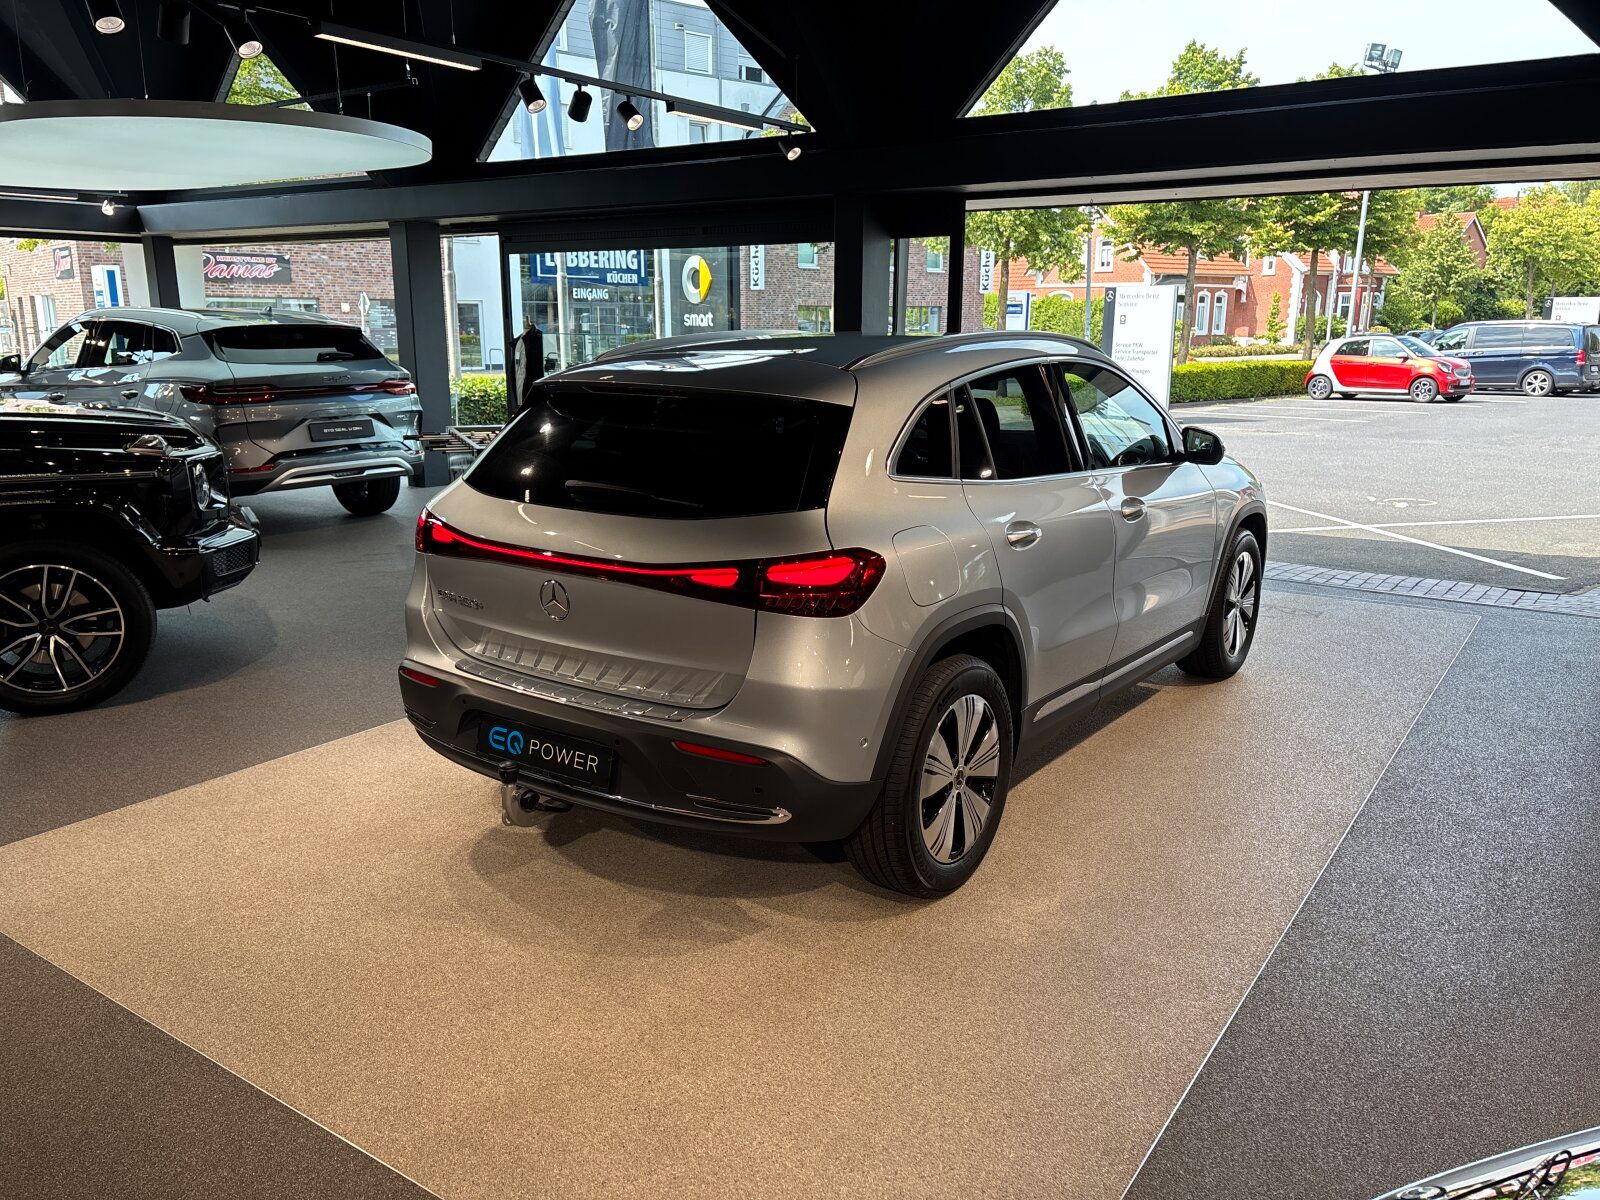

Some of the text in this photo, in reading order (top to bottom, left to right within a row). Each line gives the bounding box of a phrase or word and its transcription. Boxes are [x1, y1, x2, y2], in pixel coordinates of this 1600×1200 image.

[545, 250, 638, 270] LBBERING
[606, 271, 638, 284] KÜCHEN
[982, 252, 991, 291] Küche
[572, 288, 609, 300] EINGANG
[683, 311, 714, 327] smart
[489, 726, 599, 774] EQ POWER
